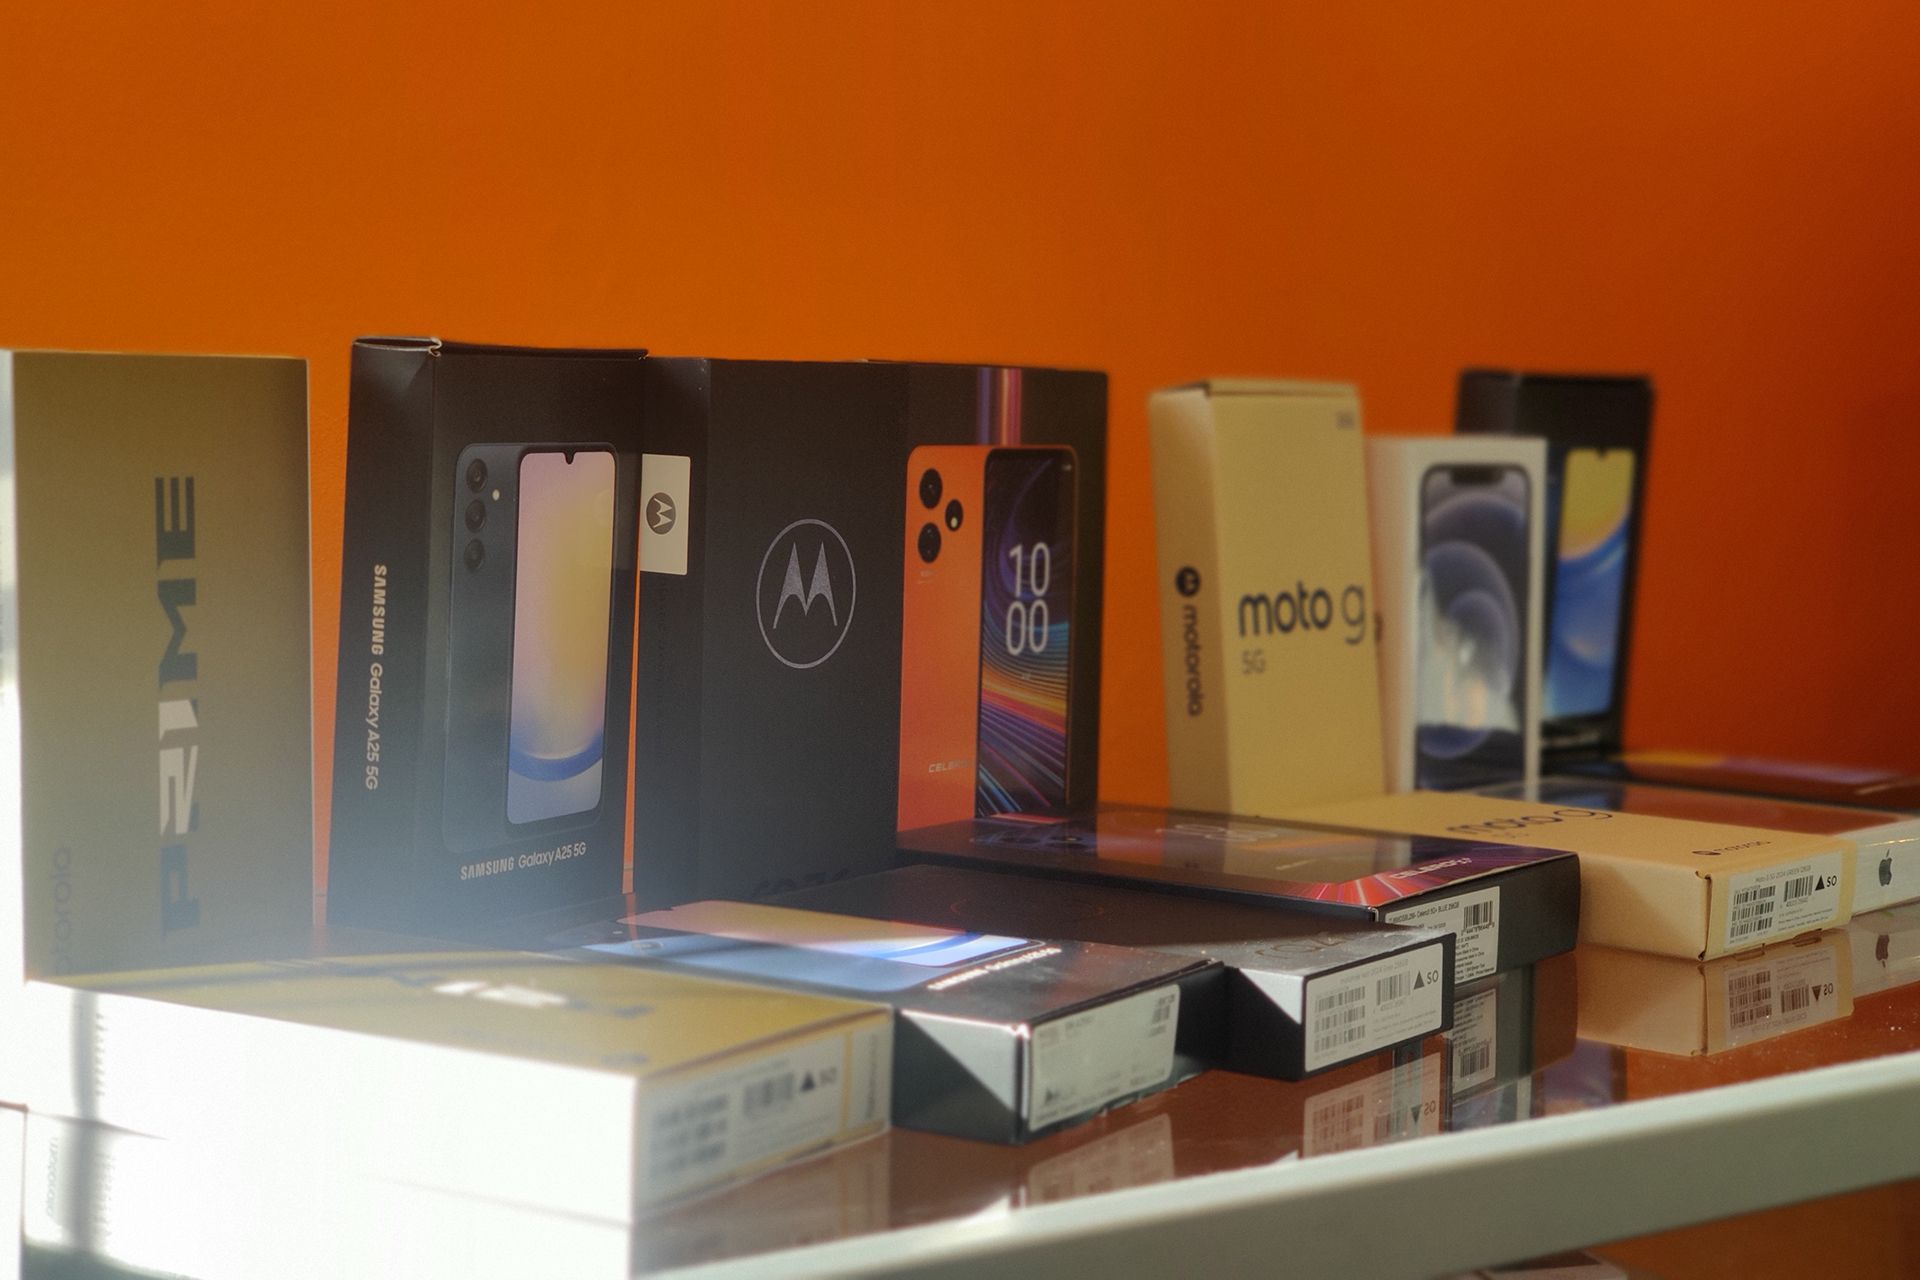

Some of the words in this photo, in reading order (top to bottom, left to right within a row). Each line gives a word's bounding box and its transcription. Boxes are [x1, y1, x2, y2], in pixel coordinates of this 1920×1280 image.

[1008, 542, 1050, 597] 10
[371, 564, 387, 656] SAMSUNG
[1006, 599, 1049, 656] 00
[1238, 579, 1333, 638] moto
[1340, 583, 1366, 645] g
[1183, 604, 1204, 717] motorola
[1242, 648, 1266, 675] 5G
[366, 662, 383, 730] Galaxy
[366, 728, 380, 762] A25
[365, 766, 379, 790] 5G
[460, 856, 515, 880] SAMSUNG
[518, 851, 555, 869] Galaxy
[554, 844, 572, 861] A25
[574, 841, 587, 857] 5G
[1826, 875, 1838, 888] SO
[1426, 969, 1439, 985] SO
